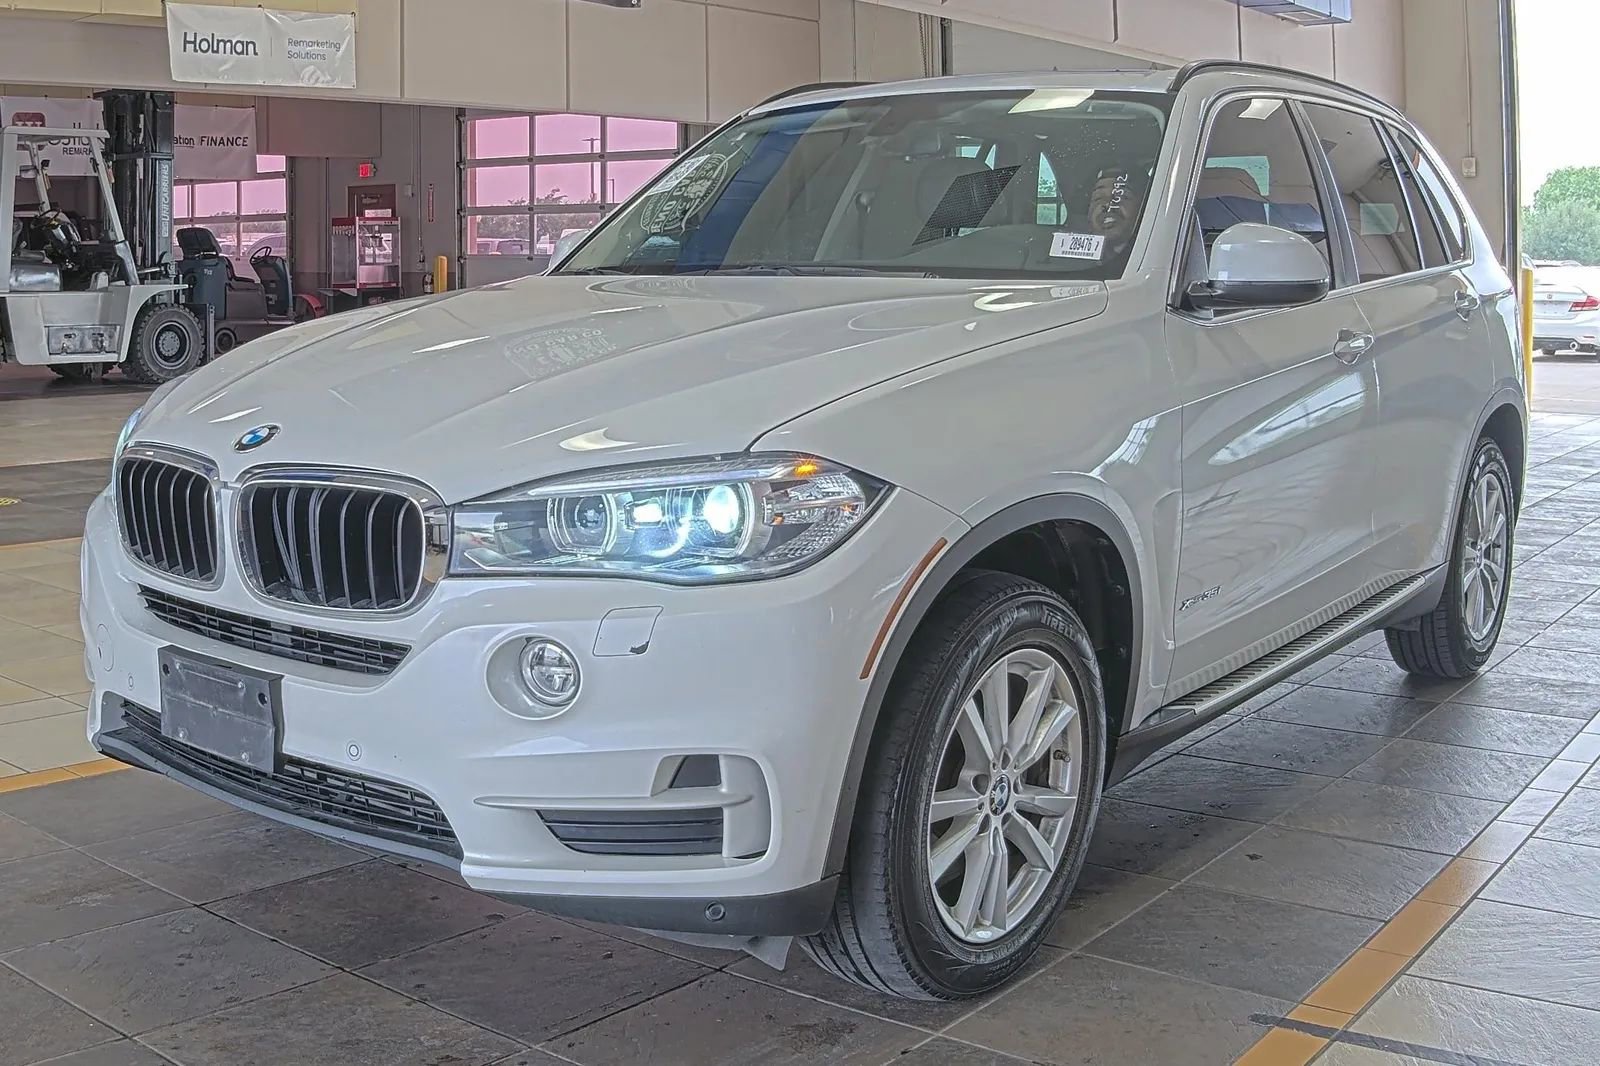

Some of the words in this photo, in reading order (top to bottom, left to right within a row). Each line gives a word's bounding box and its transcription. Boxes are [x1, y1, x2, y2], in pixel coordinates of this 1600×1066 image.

[183, 32, 258, 56] Holman
[287, 38, 341, 52] Remarketing
[287, 50, 327, 61] Solutions
[200, 135, 249, 147] FINANCE
